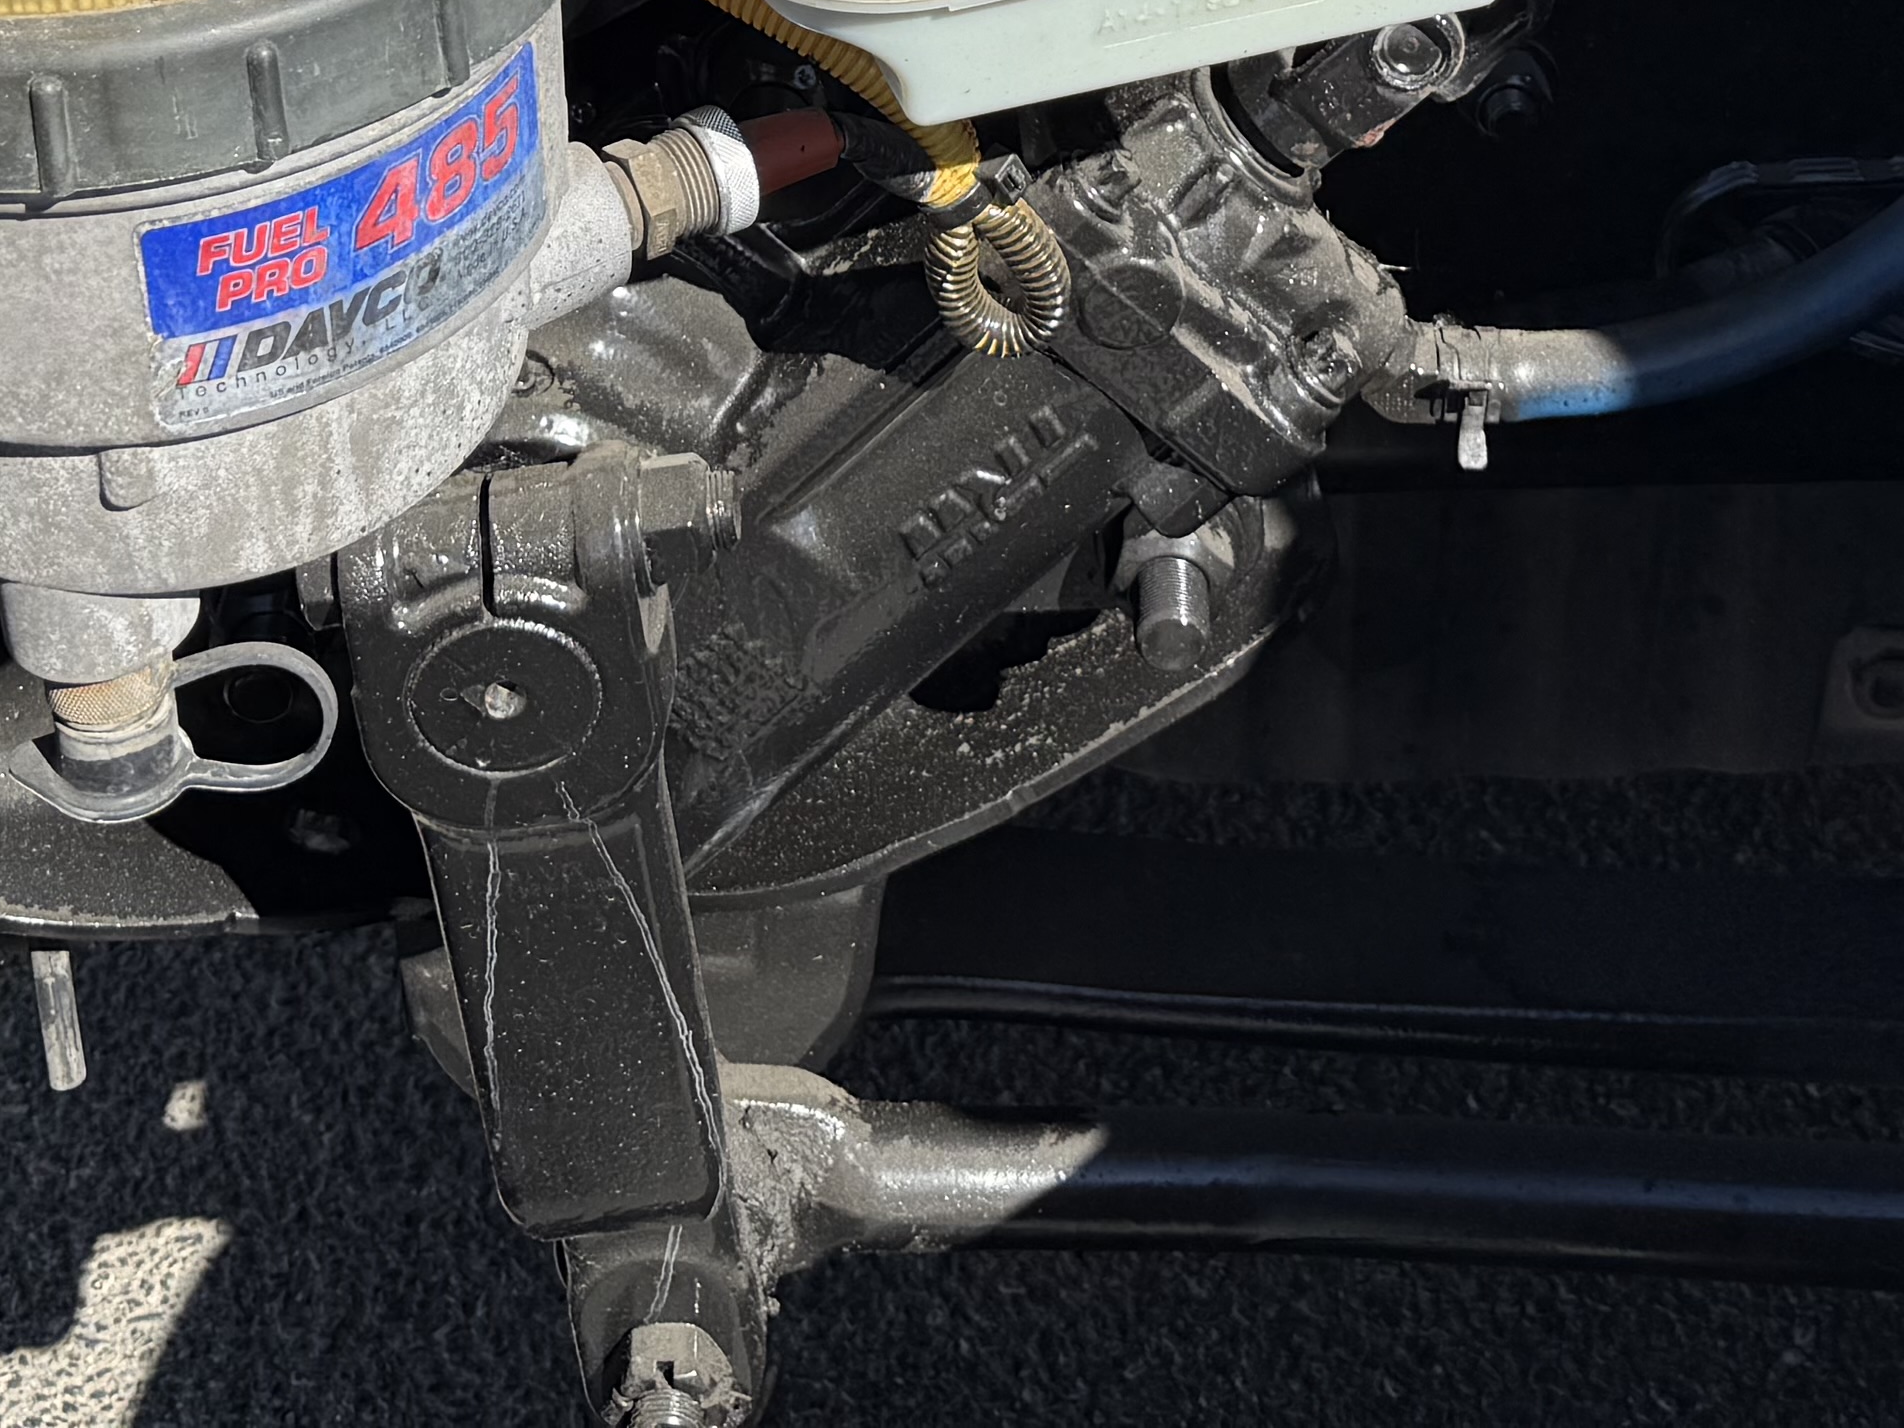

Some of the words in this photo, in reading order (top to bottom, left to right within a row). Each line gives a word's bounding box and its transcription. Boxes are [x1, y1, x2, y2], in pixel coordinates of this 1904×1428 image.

[352, 68, 521, 255] 485
[197, 205, 330, 277] FUEL
[215, 245, 328, 312] PRO
